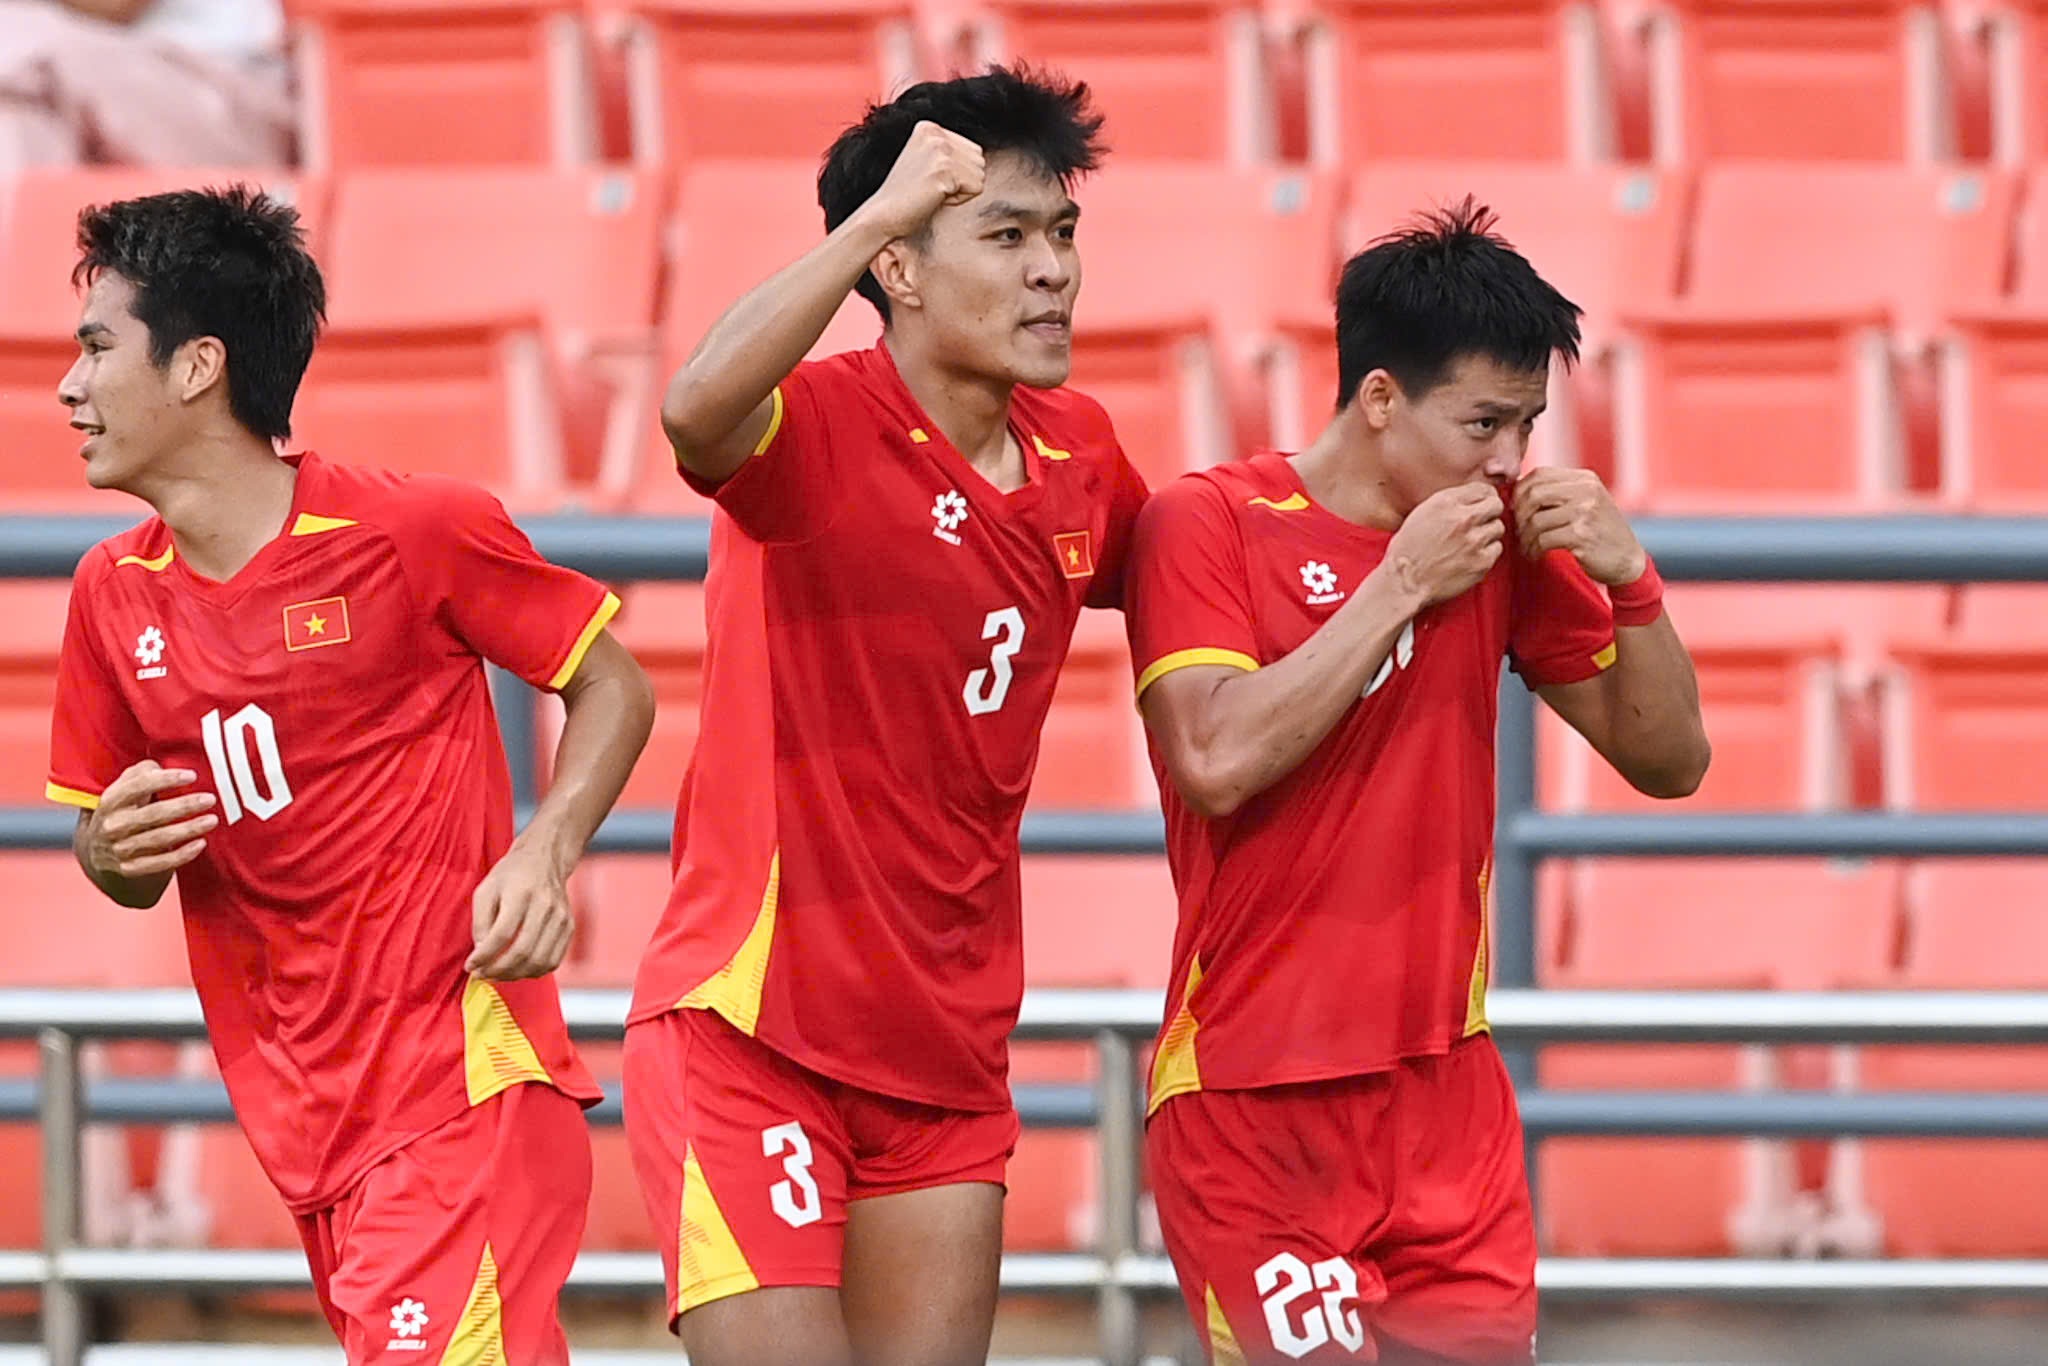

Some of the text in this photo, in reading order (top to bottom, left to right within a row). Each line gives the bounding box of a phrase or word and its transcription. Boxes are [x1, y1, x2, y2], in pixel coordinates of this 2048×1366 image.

[962, 606, 1025, 716] 3
[201, 703, 293, 826] 10
[761, 1120, 822, 1228] 3
[1254, 1251, 1364, 1359] 22
